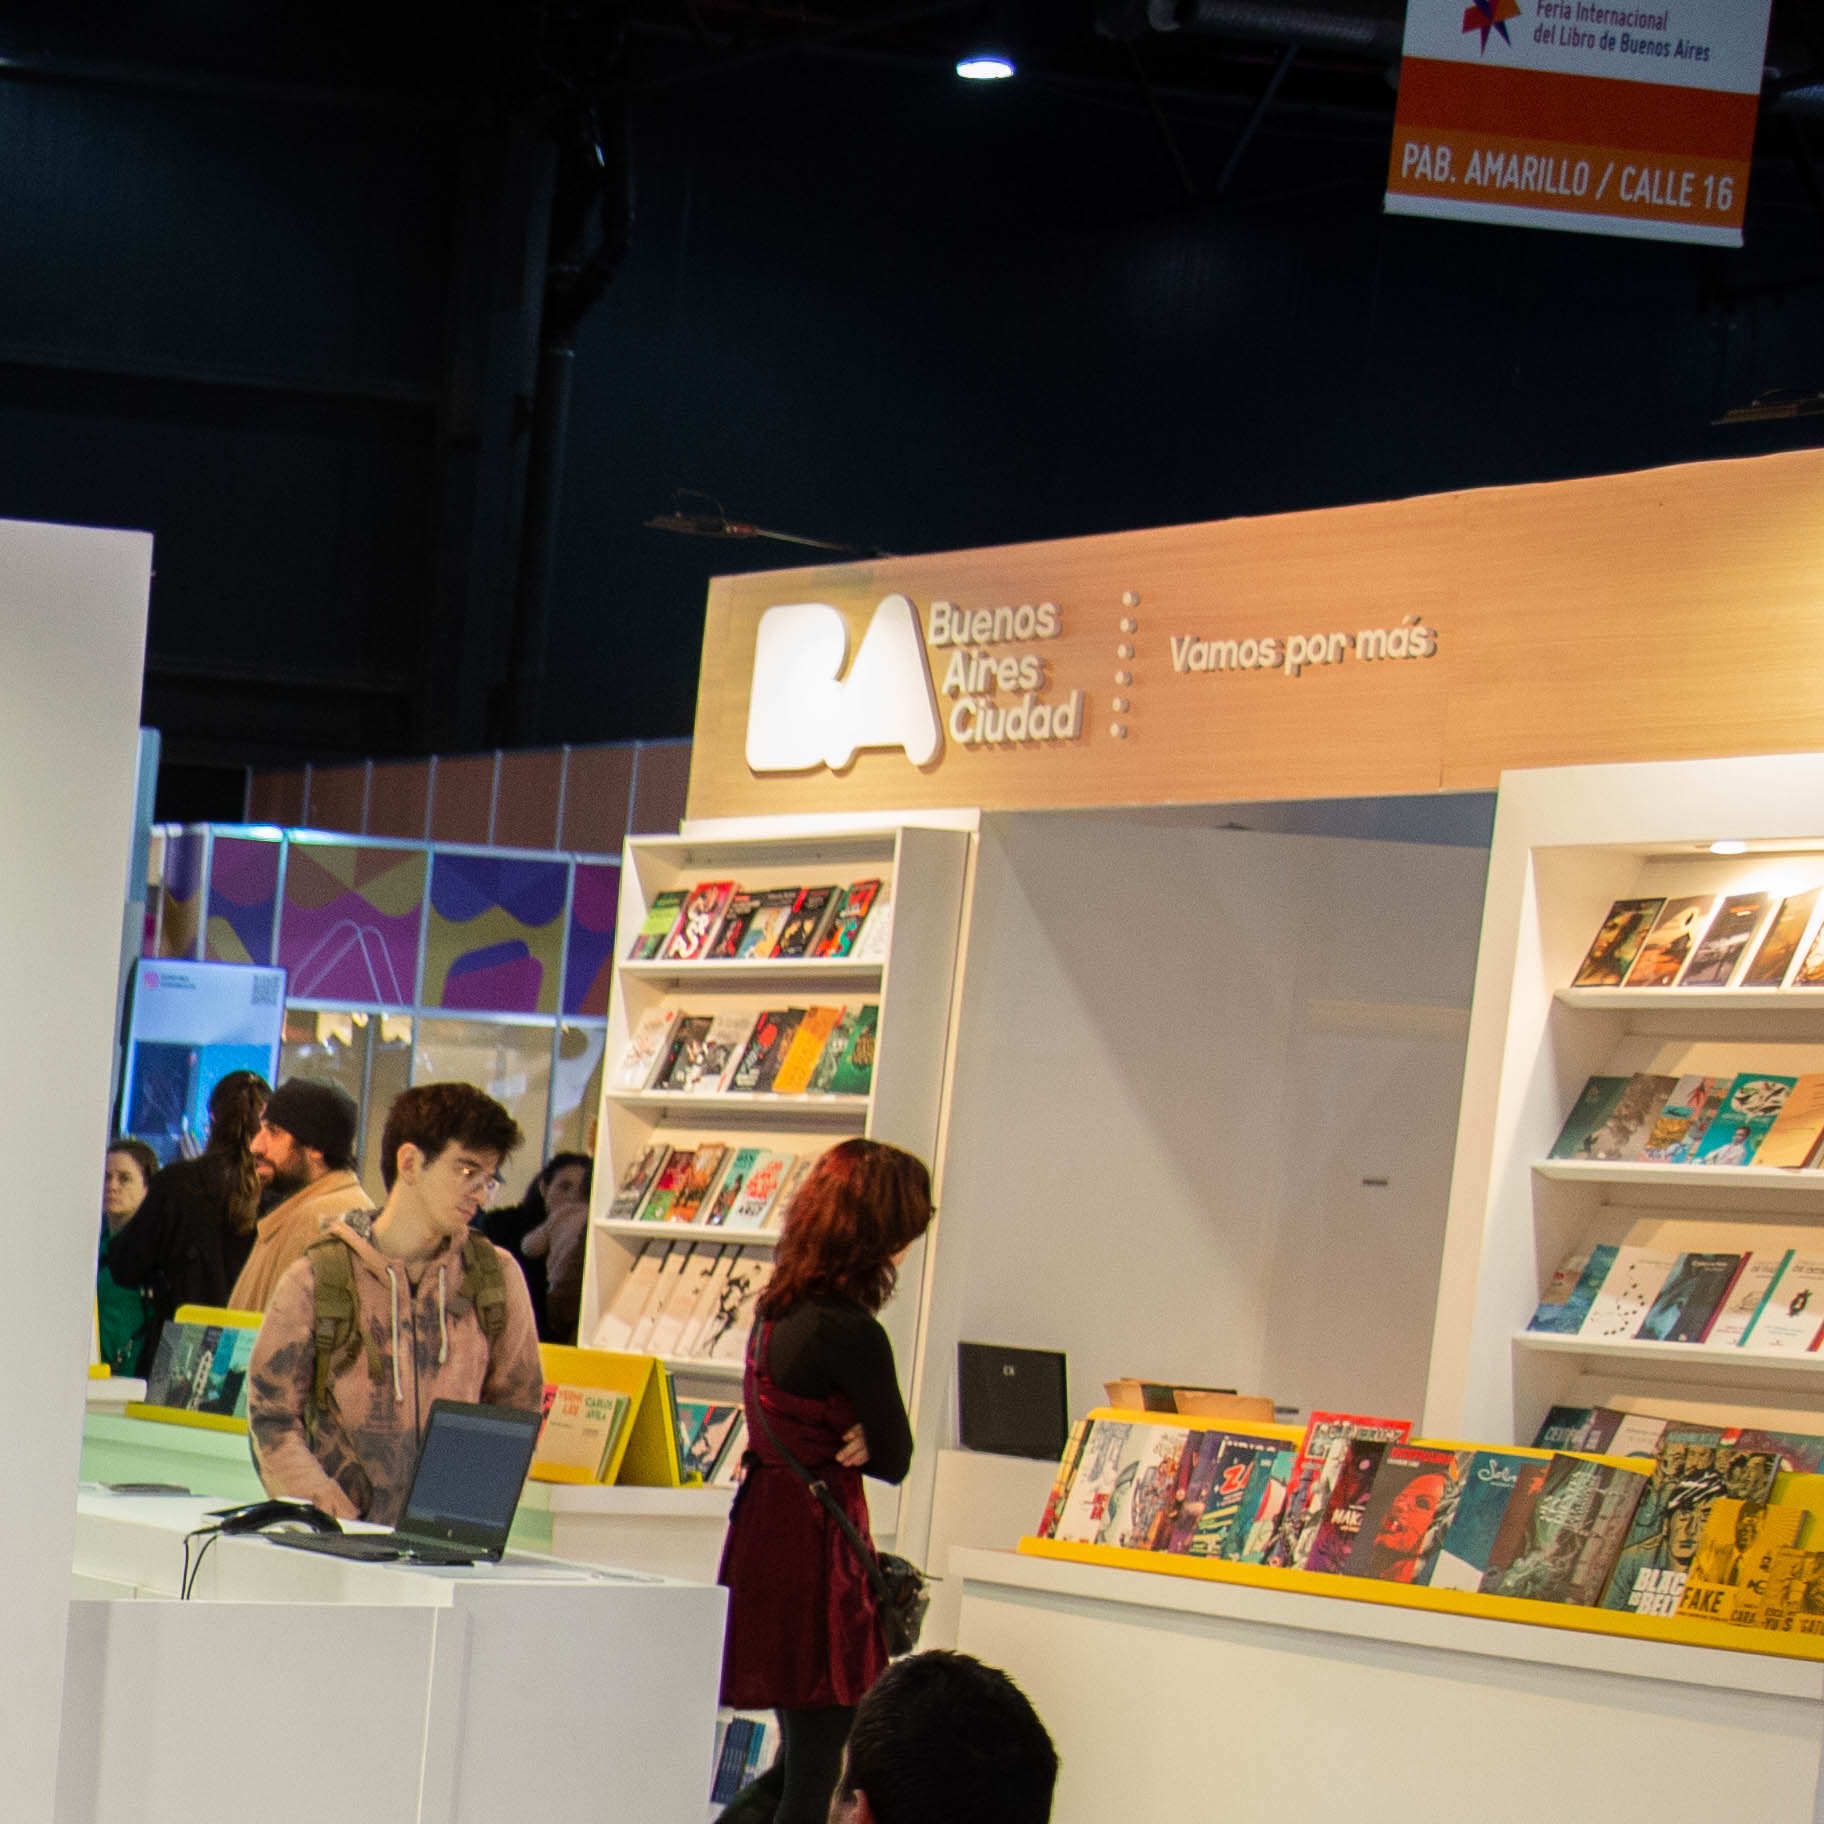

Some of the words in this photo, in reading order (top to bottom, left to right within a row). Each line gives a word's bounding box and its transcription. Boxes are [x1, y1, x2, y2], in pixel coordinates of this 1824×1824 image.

[1536, 0, 1571, 20] Feria
[1575, 2, 1669, 32] Internacional
[1533, 23, 1556, 44] del
[1559, 26, 1595, 49] Libro
[1599, 31, 1616, 51] de
[1620, 32, 1670, 58] Buenos
[1673, 38, 1712, 62] Aires
[1401, 143, 1456, 184] PAB.
[1464, 149, 1590, 198] AMARILLO
[1618, 166, 1693, 208] CALLE
[1702, 174, 1735, 212] 16
[928, 601, 1062, 646] Buenos
[1168, 634, 1277, 673] Vamos
[1283, 631, 1350, 677] por
[1356, 614, 1439, 661] más
[745, 594, 944, 772] BA
[941, 650, 1043, 697] Aires
[949, 690, 1086, 747] Ciudad
[1632, 1567, 1688, 1596] BLAC
[1680, 1586, 1726, 1614] FAKE
